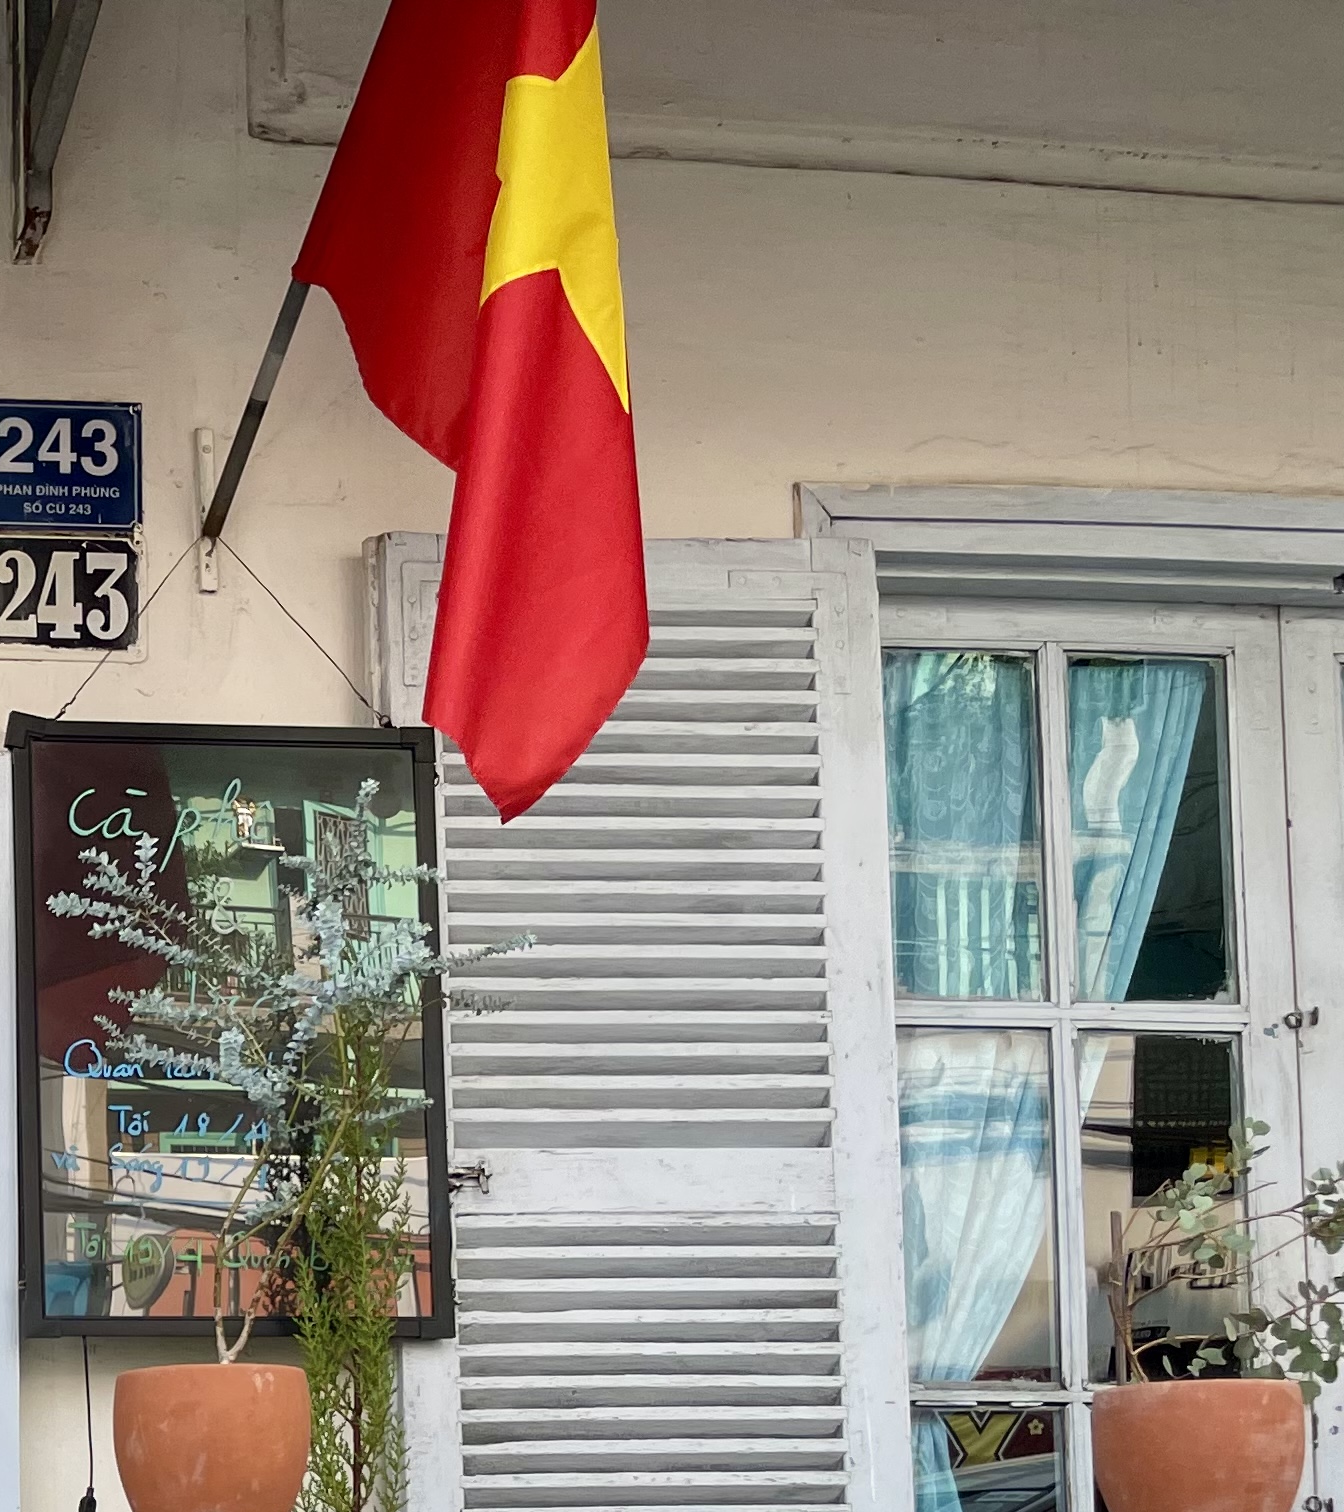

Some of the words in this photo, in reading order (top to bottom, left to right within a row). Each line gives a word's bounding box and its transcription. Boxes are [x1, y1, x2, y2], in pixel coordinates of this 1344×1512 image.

[23, 499, 41, 514] SỐ
[68, 503, 92, 515] 243
[35, 483, 67, 496] ĐÌNH
[72, 484, 120, 498] PHÙNG
[68, 787, 144, 839] Cà
[211, 876, 246, 935] &
